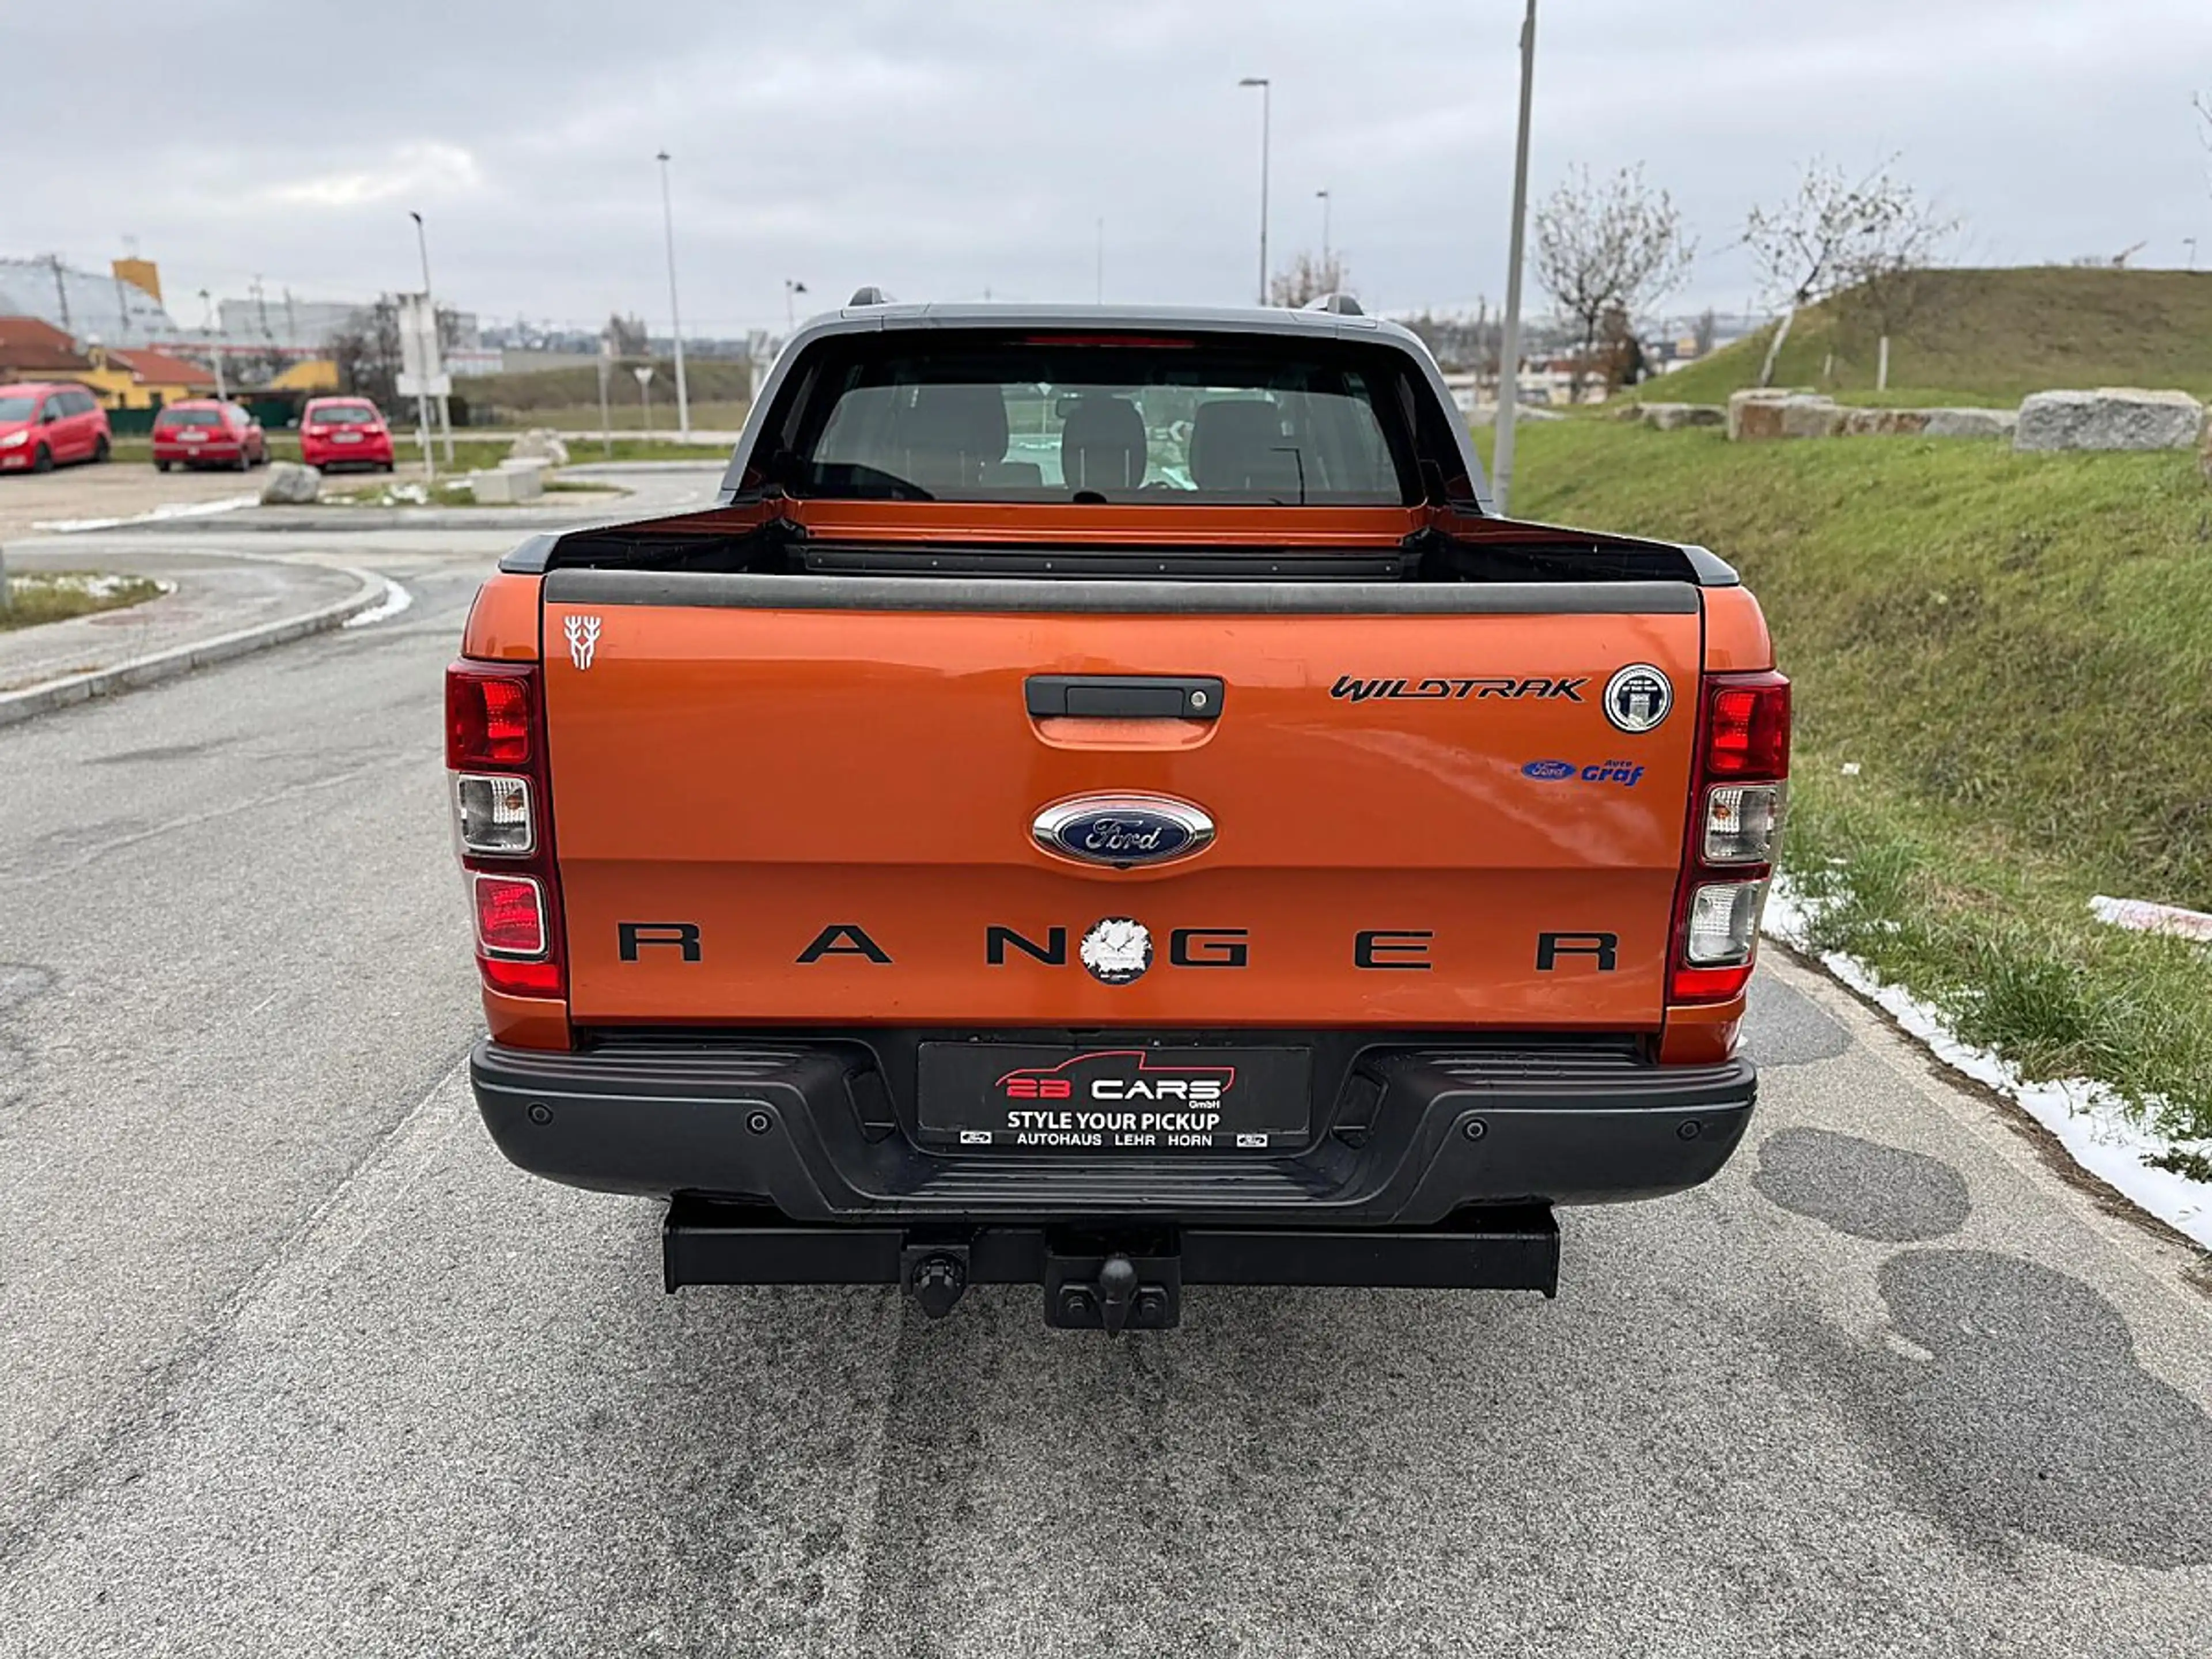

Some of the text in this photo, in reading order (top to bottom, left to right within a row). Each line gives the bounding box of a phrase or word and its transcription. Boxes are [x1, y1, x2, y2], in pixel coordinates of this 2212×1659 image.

[1330, 675, 1590, 702] WILDTRAK
[1581, 766, 1645, 786] Graf
[1085, 818, 1162, 850] Ford
[618, 922, 1618, 971] RANGER
[1092, 1080, 1221, 1100] CARS
[1189, 1100, 1220, 1109] GmbH
[1007, 1112, 1221, 1131] STYLE YOUR PICKUP
[1017, 1133, 1213, 1146] AUTOHAUS LEHR HORN
